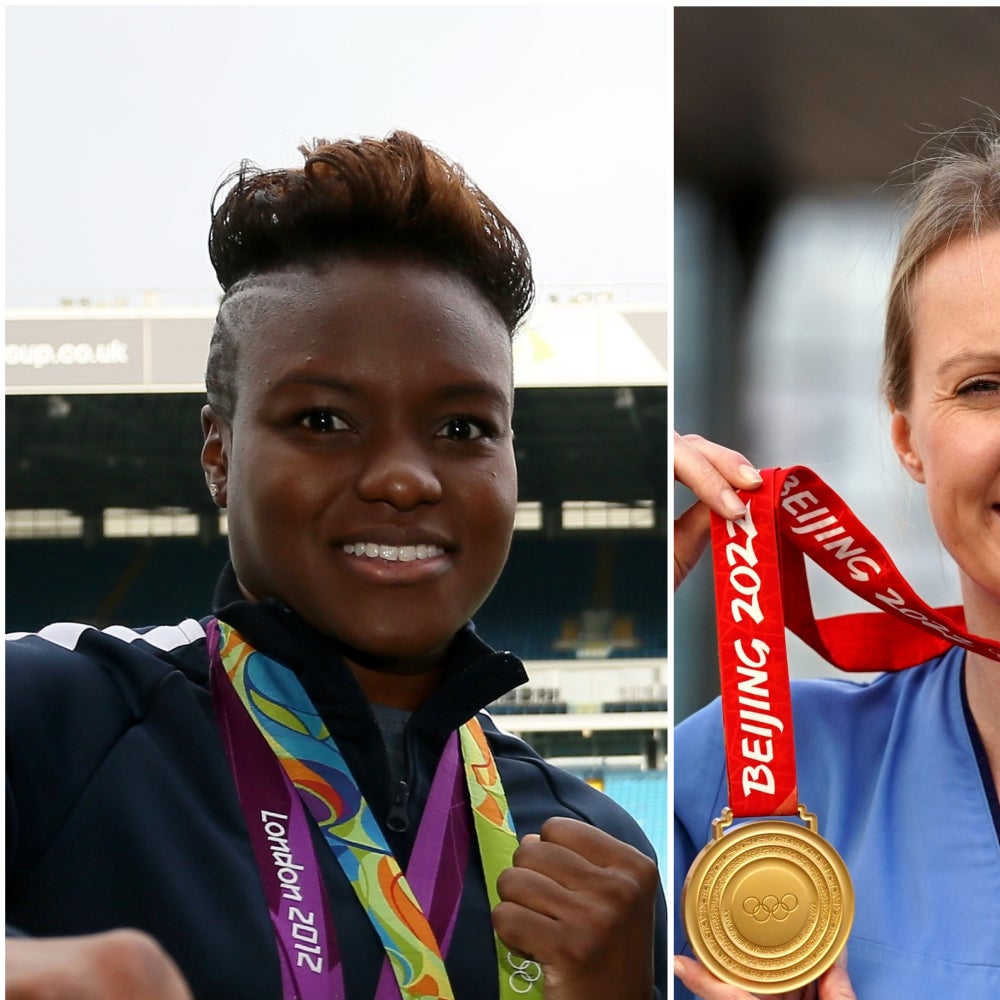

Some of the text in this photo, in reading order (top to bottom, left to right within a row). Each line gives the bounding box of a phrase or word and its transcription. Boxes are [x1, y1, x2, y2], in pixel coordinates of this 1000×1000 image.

[780, 475, 975, 648] BEIJING 2022
[725, 498, 784, 799] BEIJING 2022
[260, 810, 323, 974] London 2012
